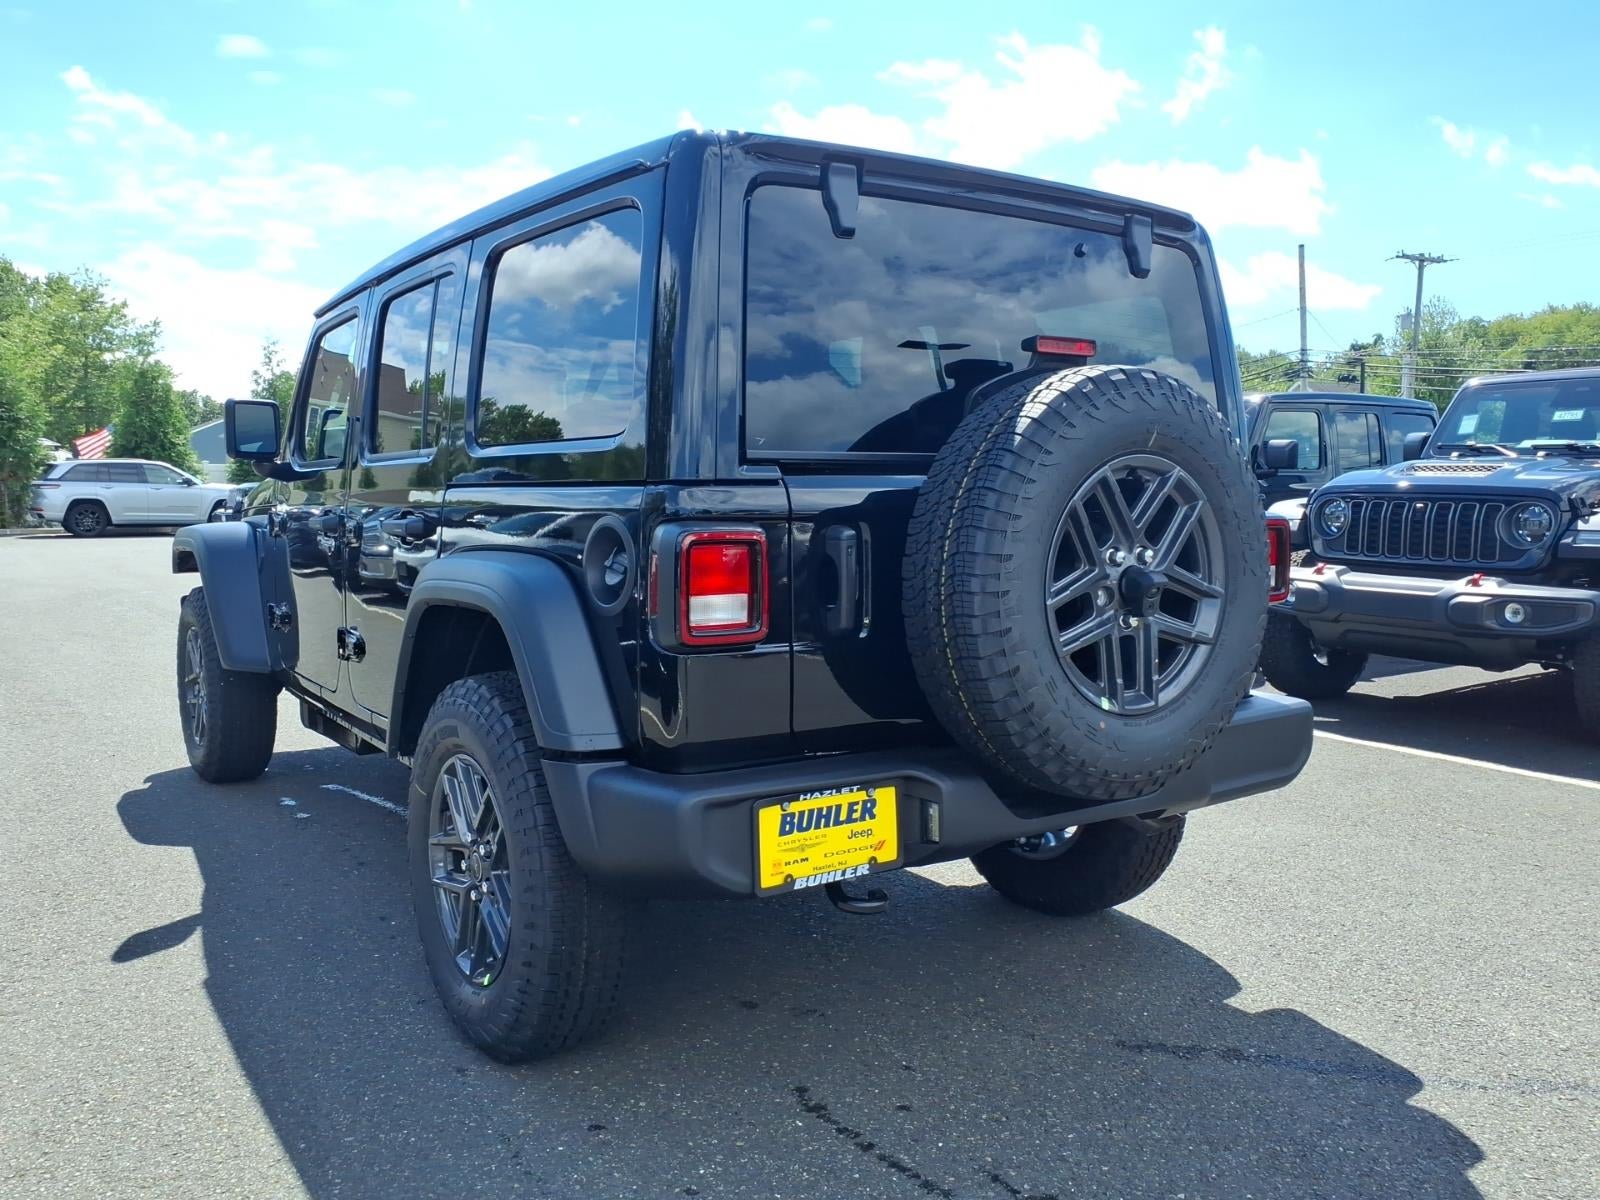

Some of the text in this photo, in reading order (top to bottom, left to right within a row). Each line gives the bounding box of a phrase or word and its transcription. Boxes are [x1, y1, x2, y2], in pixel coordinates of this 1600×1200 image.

[799, 785, 861, 801] HAZLET
[778, 798, 877, 837] BUHLER
[777, 833, 827, 848] CHRYSLER
[847, 828, 873, 840] Jeep
[824, 844, 877, 858] DODGE
[784, 857, 809, 867] RAM
[837, 860, 848, 868] NJ
[793, 864, 870, 890] BUHLER
